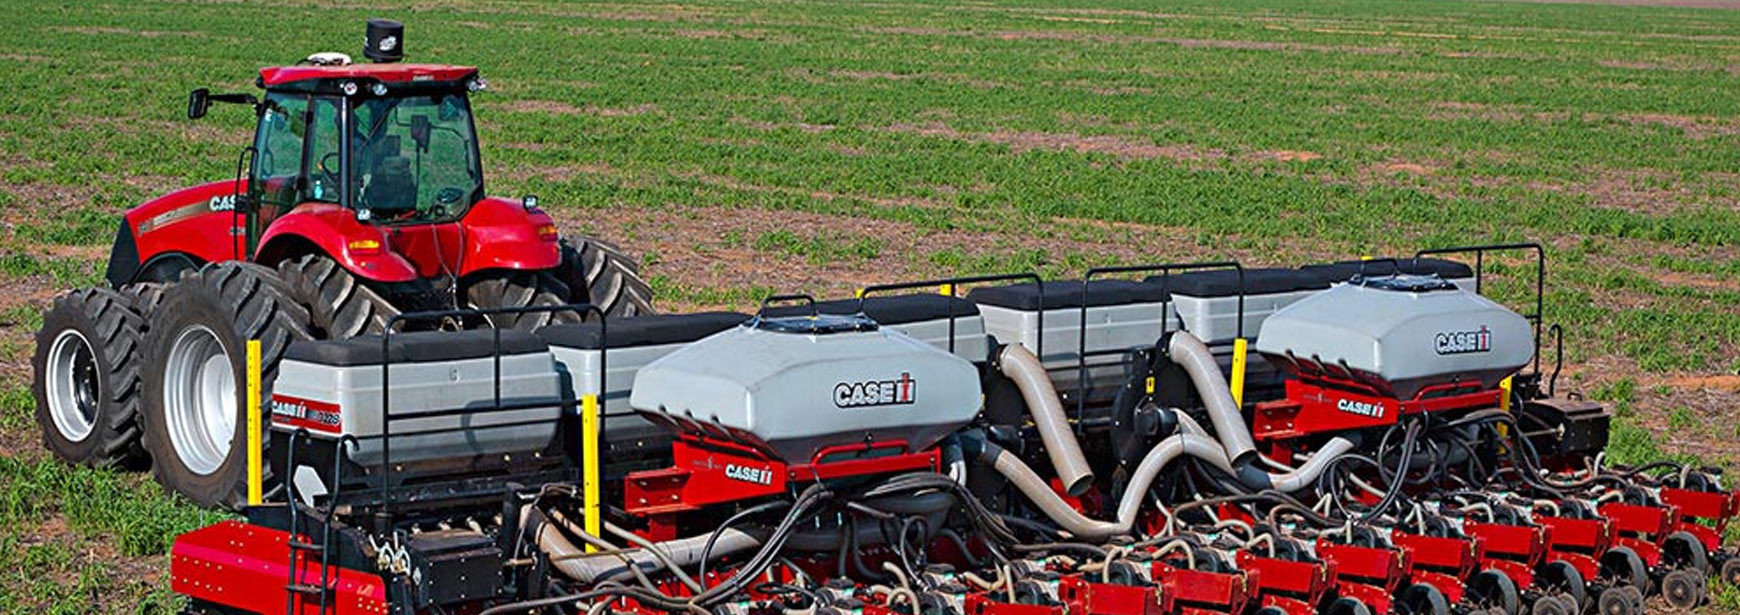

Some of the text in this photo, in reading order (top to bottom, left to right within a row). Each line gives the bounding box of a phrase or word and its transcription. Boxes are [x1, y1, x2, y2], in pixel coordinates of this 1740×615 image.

[1435, 331, 1477, 355] CASE
[833, 381, 896, 408] CASE
[1337, 398, 1373, 416] CASE
[725, 463, 760, 483] CASE
